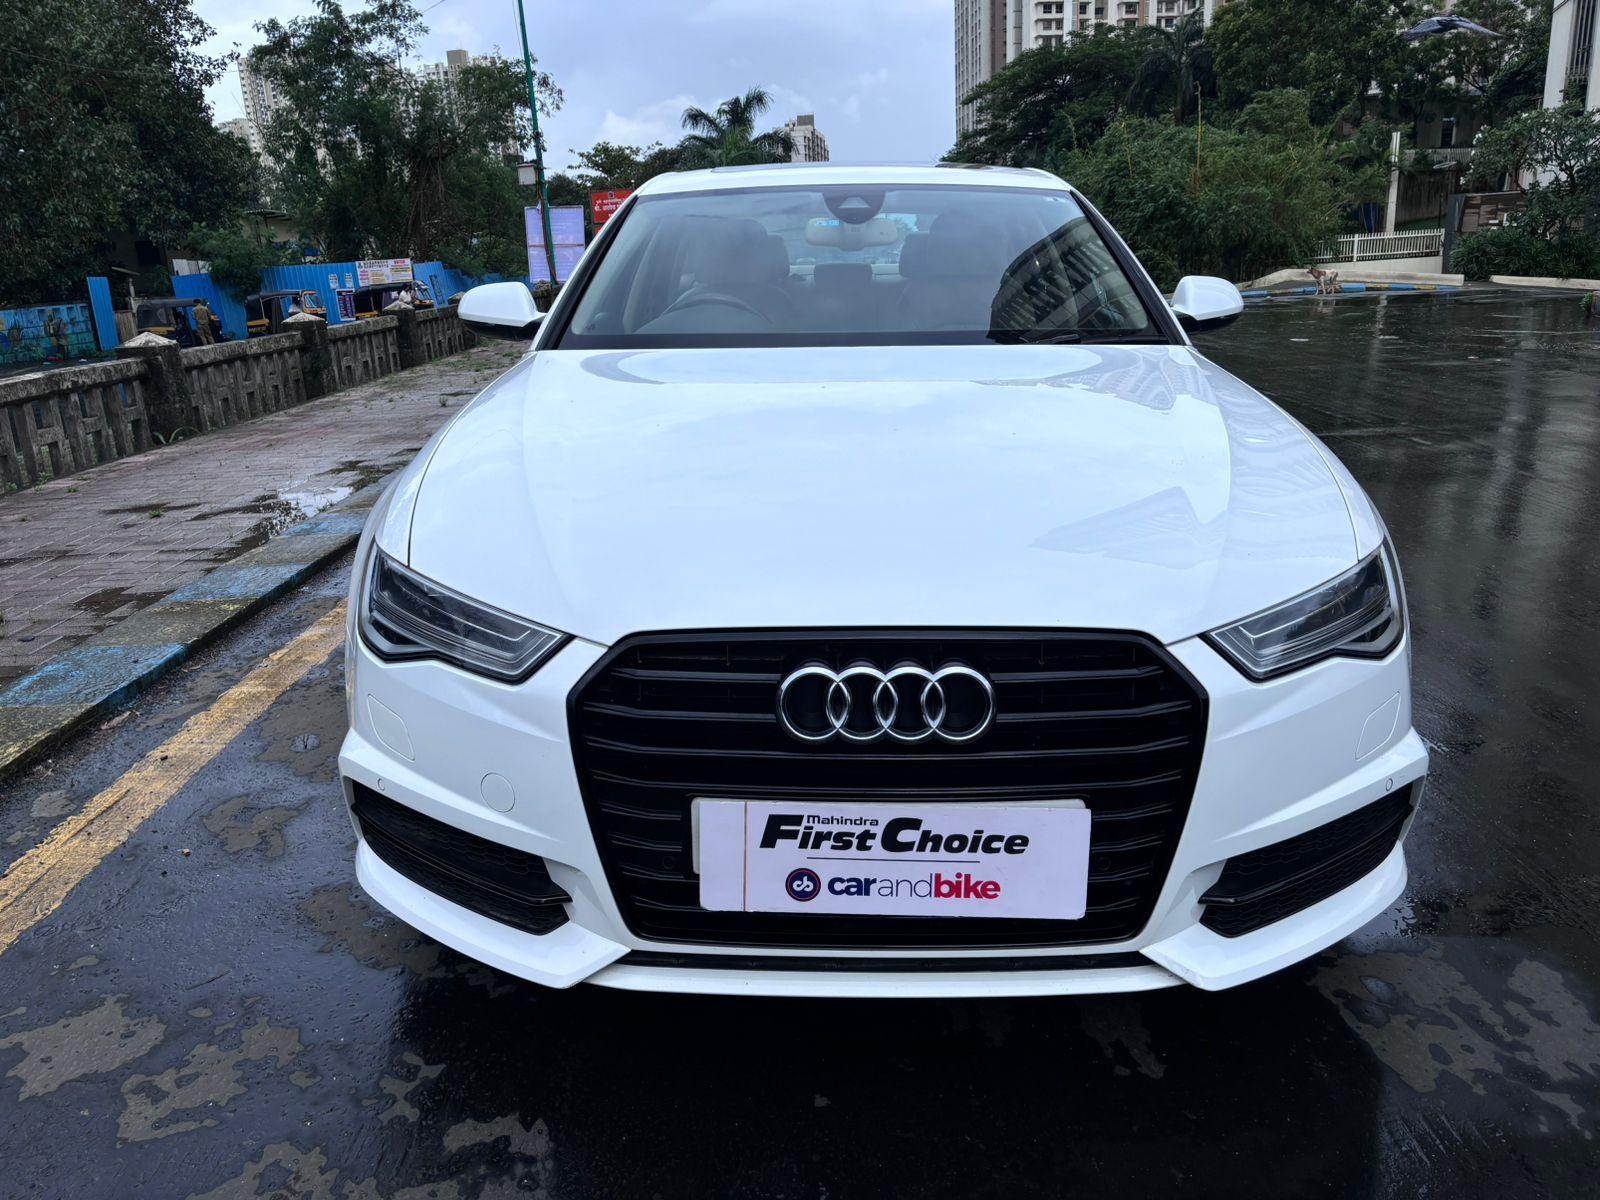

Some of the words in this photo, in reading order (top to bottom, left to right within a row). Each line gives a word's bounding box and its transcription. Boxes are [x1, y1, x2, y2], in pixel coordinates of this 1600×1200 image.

[806, 815, 879, 826] Mahindra
[759, 814, 877, 851] First
[881, 817, 1030, 855] Choice
[827, 872, 1001, 899] carandbike
